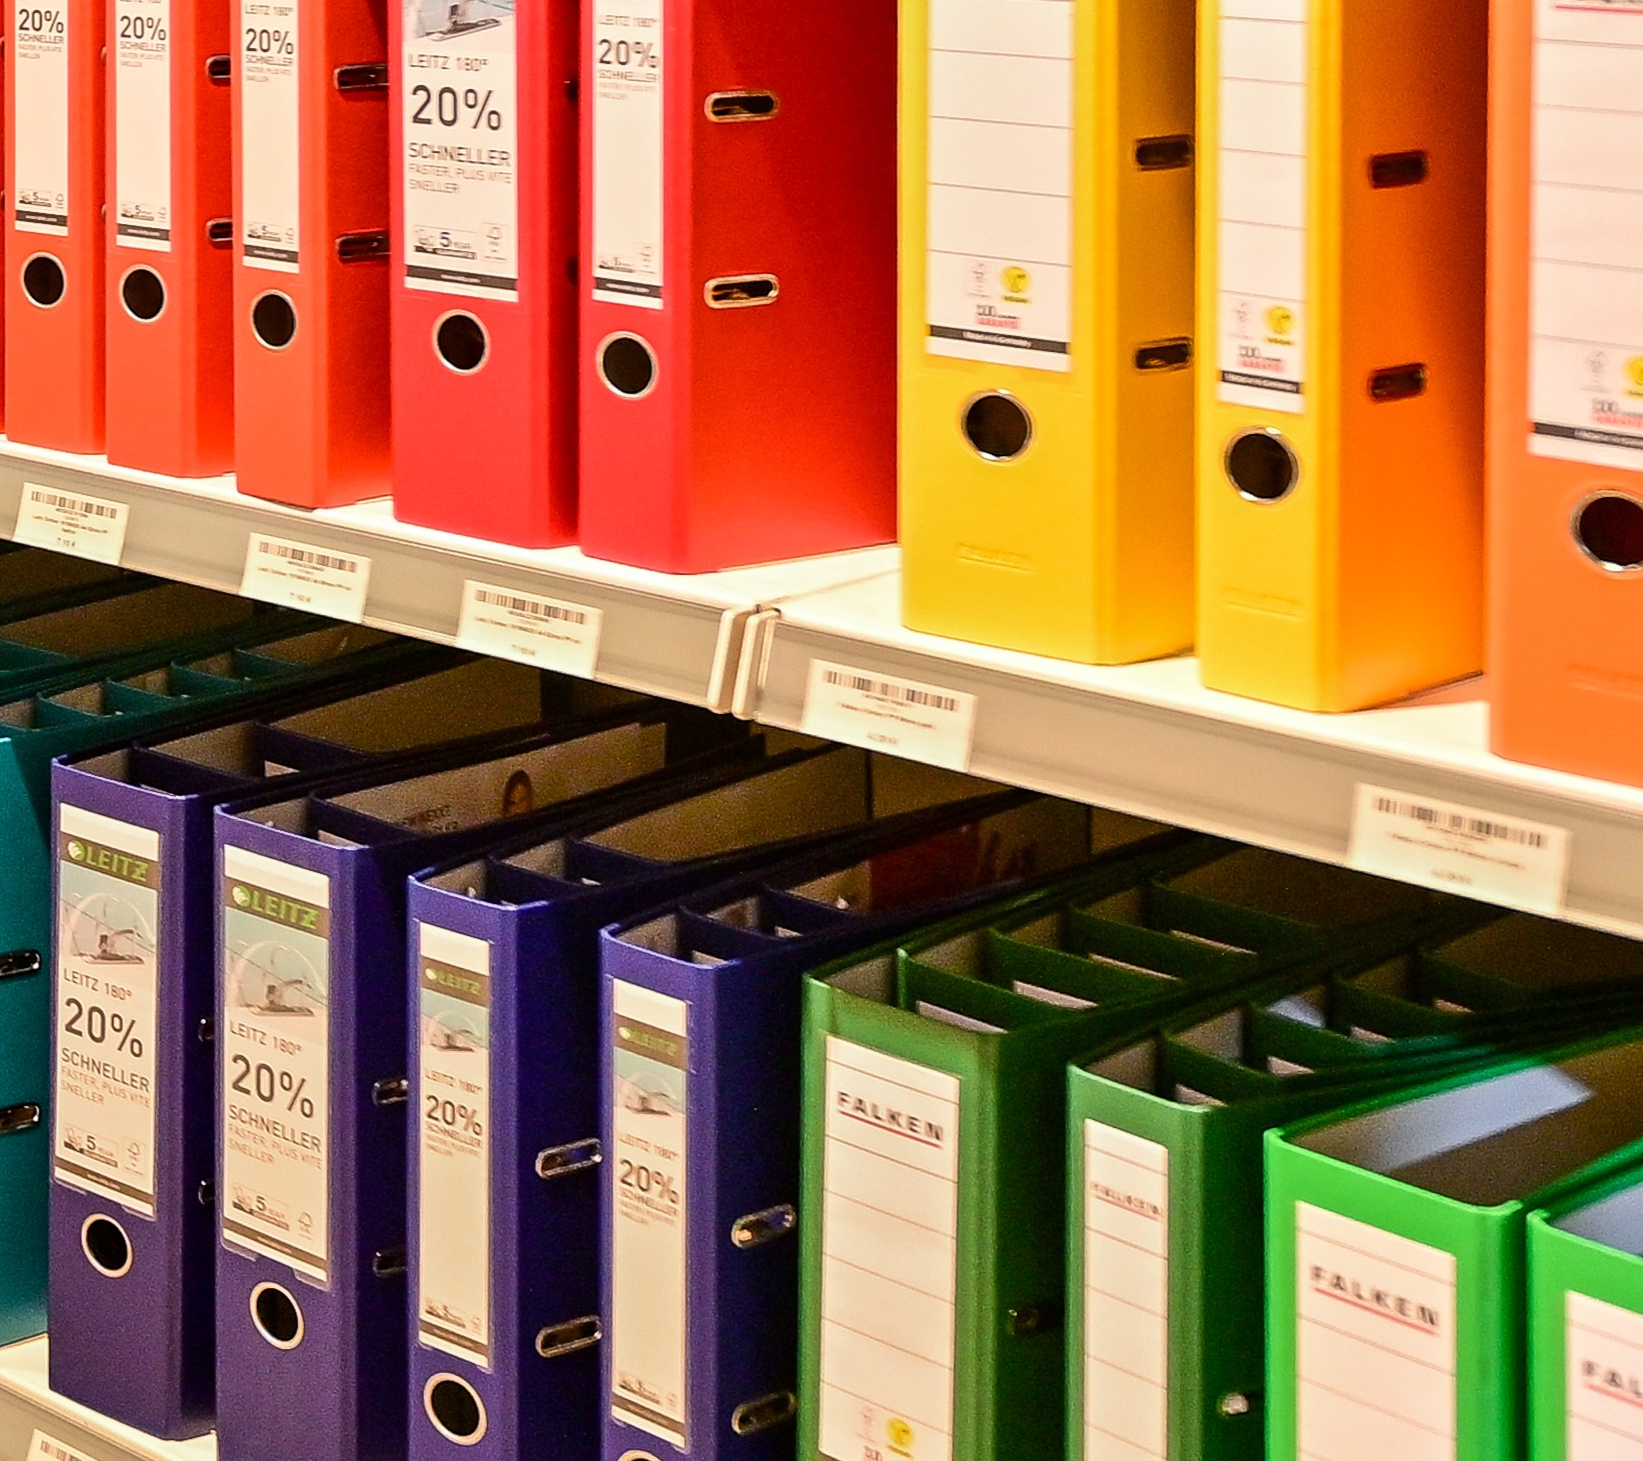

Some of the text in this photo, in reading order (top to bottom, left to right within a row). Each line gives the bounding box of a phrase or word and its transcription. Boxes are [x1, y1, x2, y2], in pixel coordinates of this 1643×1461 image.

[19, 9, 64, 33] 20%
[120, 16, 166, 41] 20%
[245, 29, 294, 55] 20%
[598, 39, 659, 69] 20%
[411, 85, 502, 132] 20%
[409, 142, 510, 166] SCHNELLER
[86, 845, 148, 882] LEITZ
[253, 891, 317, 930] LEITZ
[65, 996, 143, 1060] 20%
[62, 1047, 149, 1092] SCHNELLER
[232, 1053, 314, 1120] 20%
[229, 1105, 321, 1154] SCHNELLER
[426, 1095, 483, 1136] 20%
[831, 1090, 943, 1142] FALKEN
[620, 1159, 679, 1204] 20%
[1311, 1265, 1440, 1329] FALKEN
